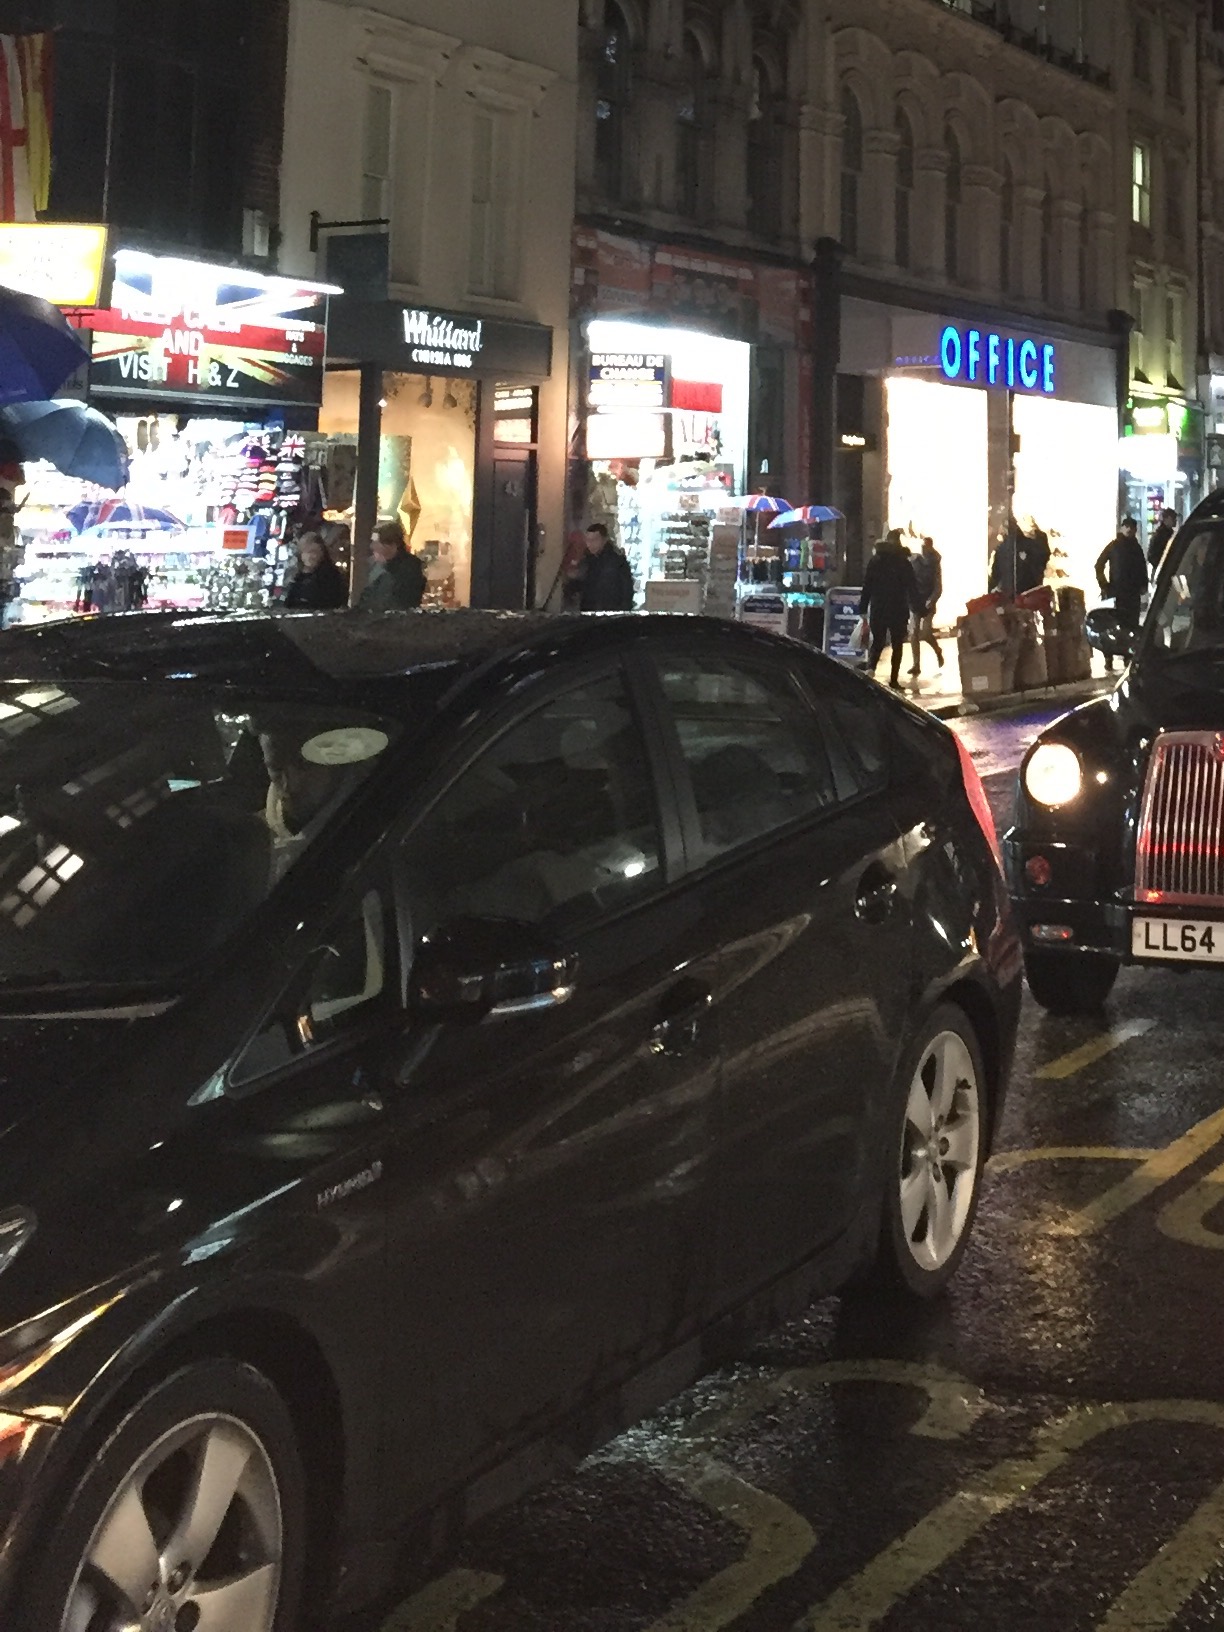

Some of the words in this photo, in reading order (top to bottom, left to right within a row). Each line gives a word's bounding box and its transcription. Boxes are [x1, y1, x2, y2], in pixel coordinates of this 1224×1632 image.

[161, 328, 205, 357] AND
[940, 325, 1055, 393] OFFICE
[118, 352, 172, 382] VISIT
[208, 361, 222, 387] &
[225, 367, 240, 388] Z
[591, 354, 644, 367] BUREAU
[646, 355, 664, 367] DE
[1144, 921, 1216, 954] LL64
